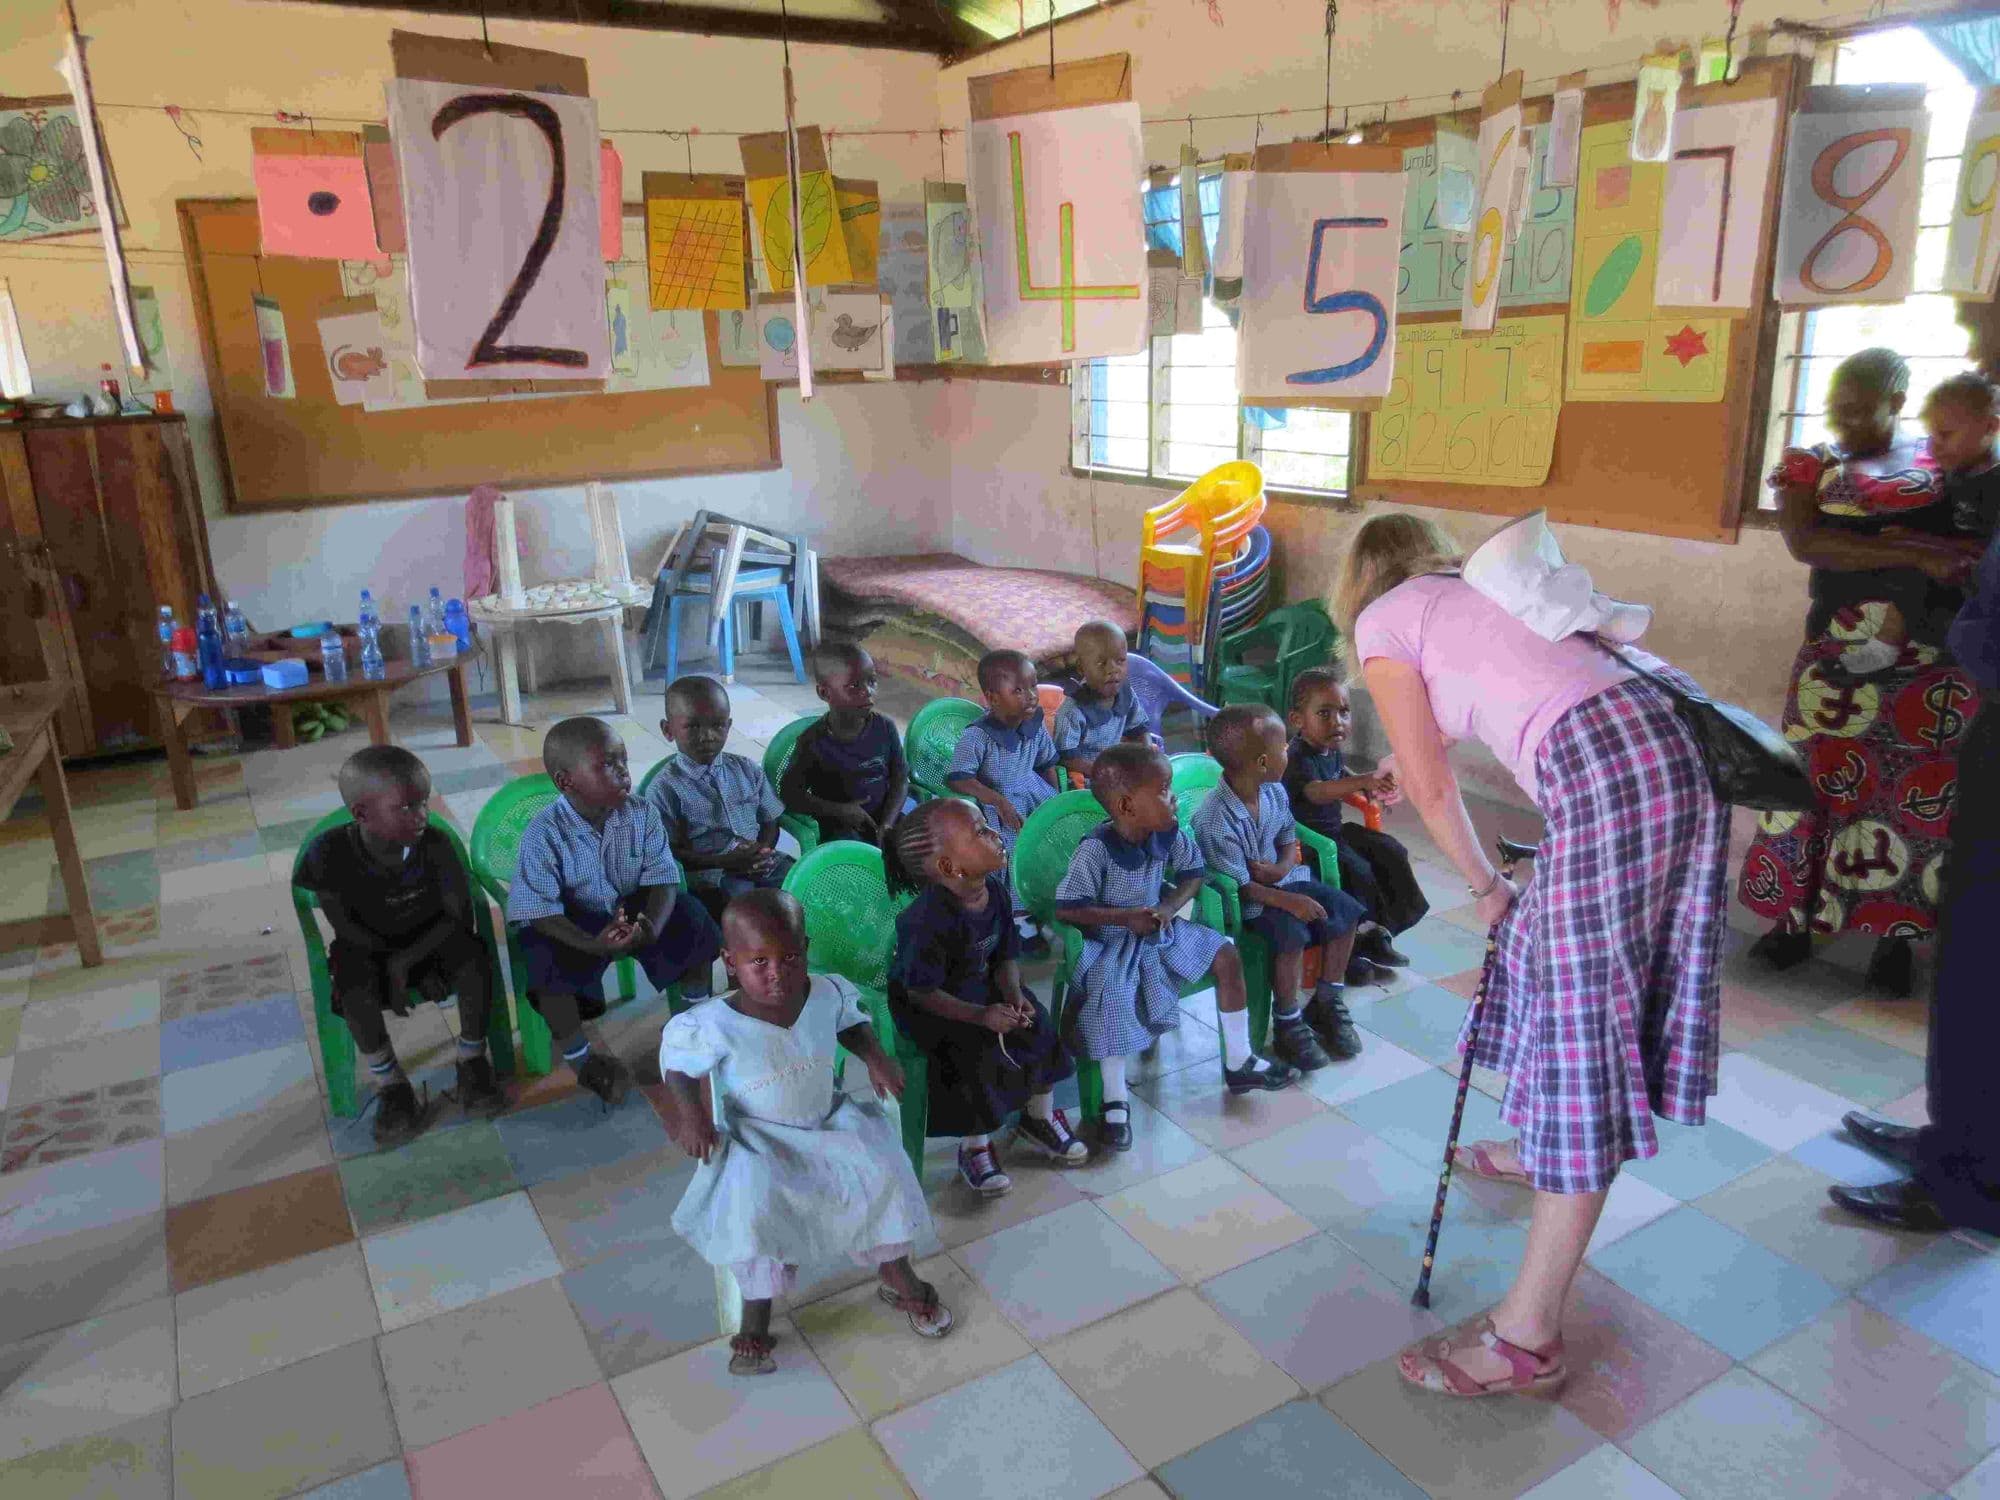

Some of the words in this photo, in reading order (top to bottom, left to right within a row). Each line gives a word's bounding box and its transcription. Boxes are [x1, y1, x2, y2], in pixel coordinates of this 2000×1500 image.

[431, 93, 589, 370] 2
[1008, 131, 1140, 353] 4
[1423, 240, 1444, 298] 7
[1472, 125, 1516, 308] 6
[1674, 145, 1735, 302] 7
[1801, 127, 1911, 295] 8
[1963, 135, 2000, 291] 9
[1285, 217, 1388, 385] 5
[1426, 349, 1444, 409] 9
[1495, 346, 1511, 404] 7
[1380, 413, 1405, 466] 8
[1408, 411, 1443, 466] 2
[1448, 411, 1480, 470] 6
